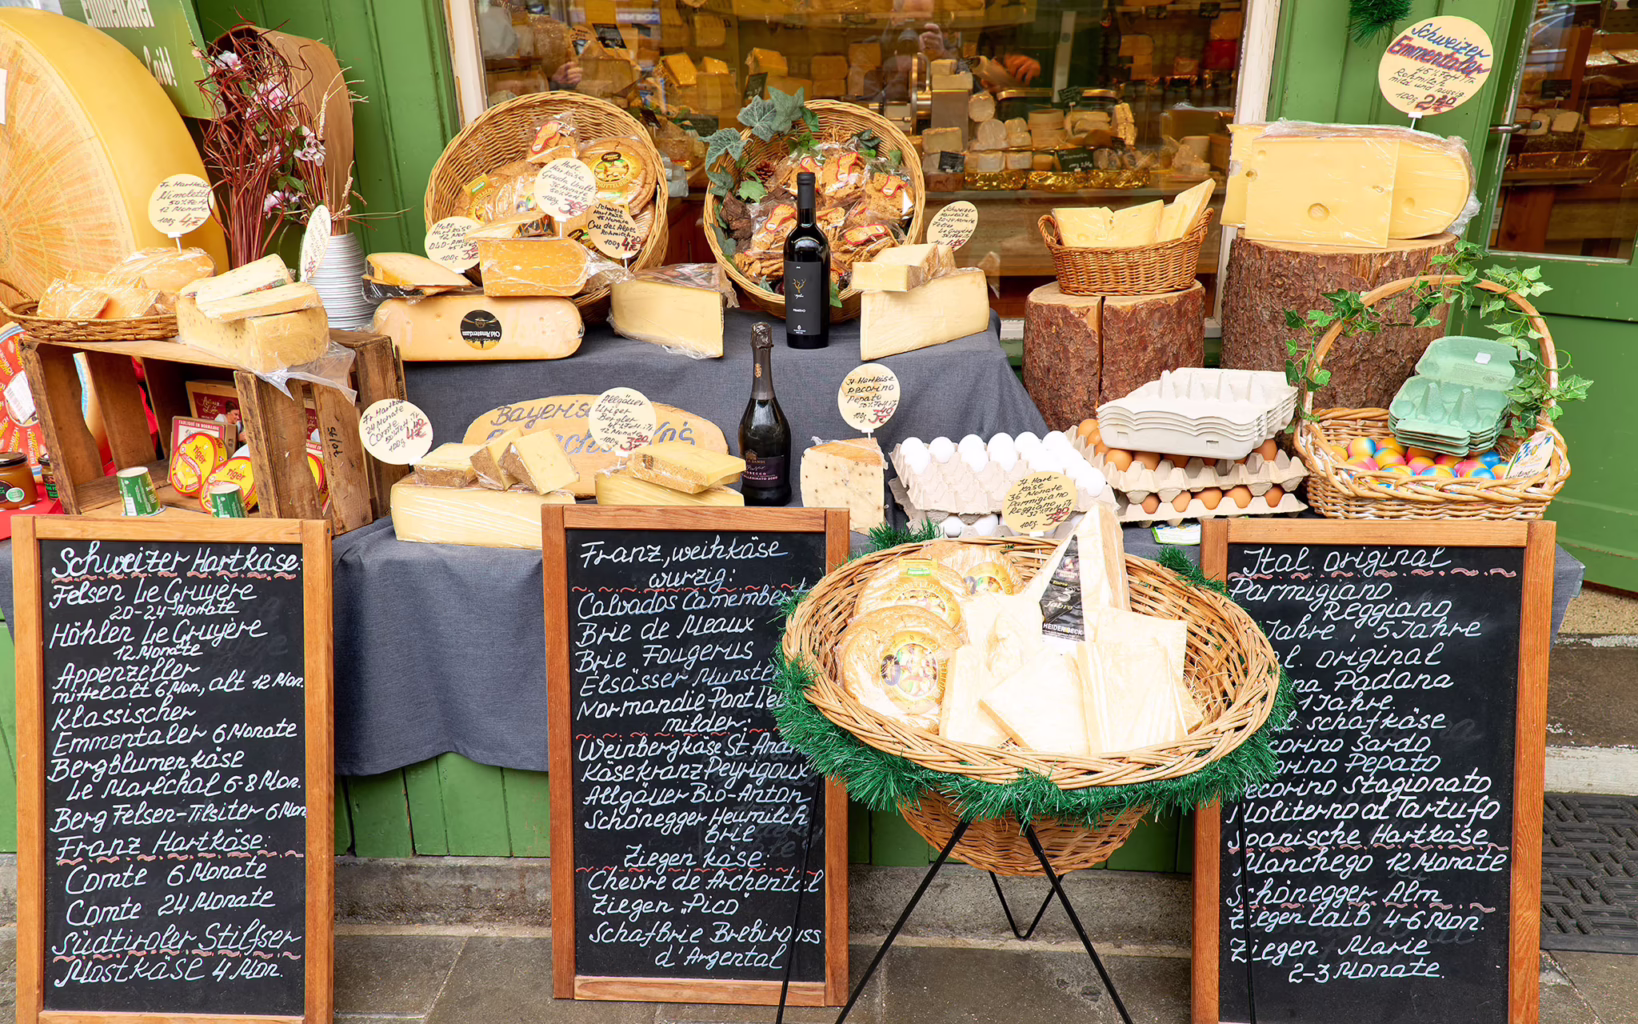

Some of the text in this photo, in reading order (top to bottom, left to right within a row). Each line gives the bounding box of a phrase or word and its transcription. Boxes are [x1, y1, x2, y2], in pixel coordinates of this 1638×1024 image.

[1387, 34, 1491, 78] Emmentaler
[1411, 22, 1491, 59] Schweizer
[52, 541, 189, 578] Schweizer
[49, 576, 257, 609] Felsen Le Gruyère
[577, 591, 678, 620] Calvados
[109, 601, 239, 621] 20-24 Monate
[1322, 600, 1452, 629] Reggiano
[49, 618, 268, 649] Höhlen Le Gruyère
[575, 615, 755, 648] Brie de Meaux
[1374, 621, 1396, 639] 5
[1391, 616, 1483, 640] Jahre
[136, 643, 204, 660] Monate
[575, 641, 753, 673] Brie Fougerus
[52, 658, 201, 690] Appenzeller
[52, 681, 151, 705] mittelalt
[208, 669, 246, 692] alt
[252, 676, 270, 690] 12
[1334, 668, 1454, 692] Padana
[51, 695, 197, 731] Klassischer
[577, 690, 705, 721] Normandie
[708, 685, 754, 709] Pont
[52, 717, 298, 757] Emmentaler 6 Monate
[578, 736, 721, 762] Weinbergkäse
[581, 757, 809, 788] Käsekranz Peyrigoux
[1345, 752, 1441, 778] Pepato
[66, 780, 94, 801] Le
[101, 771, 221, 800] Maréchal
[224, 775, 258, 794] 6-8
[582, 783, 812, 815] Allgäuer Bio-Anton
[1245, 767, 1492, 800] ecorino Stagionato
[50, 807, 107, 835] Berg
[265, 803, 280, 821] 6
[584, 805, 808, 835] Schönegger Heumilch
[1361, 798, 1389, 819] al
[1390, 796, 1501, 827] Tartufo
[56, 835, 142, 861] Franz
[1371, 822, 1489, 846] Hartkäse
[624, 844, 696, 875] Ziegen
[1386, 853, 1412, 872] 12
[1413, 848, 1508, 873] Monate
[65, 857, 268, 894] Comte 6 Monate
[587, 869, 666, 891] Chevre
[672, 869, 700, 891] de
[66, 886, 276, 926] Comte 24 Monate
[1382, 880, 1443, 904] Alm
[592, 894, 674, 922] Ziegen
[1383, 909, 1423, 929] 4-6
[52, 918, 302, 955] Südtiroler Stilfser
[588, 921, 703, 946] Schafbrie
[1230, 935, 1431, 966] Ziegen Marie
[54, 955, 205, 988] Mostkäse
[212, 962, 230, 982] 4
[1289, 963, 1330, 984] 2-3
